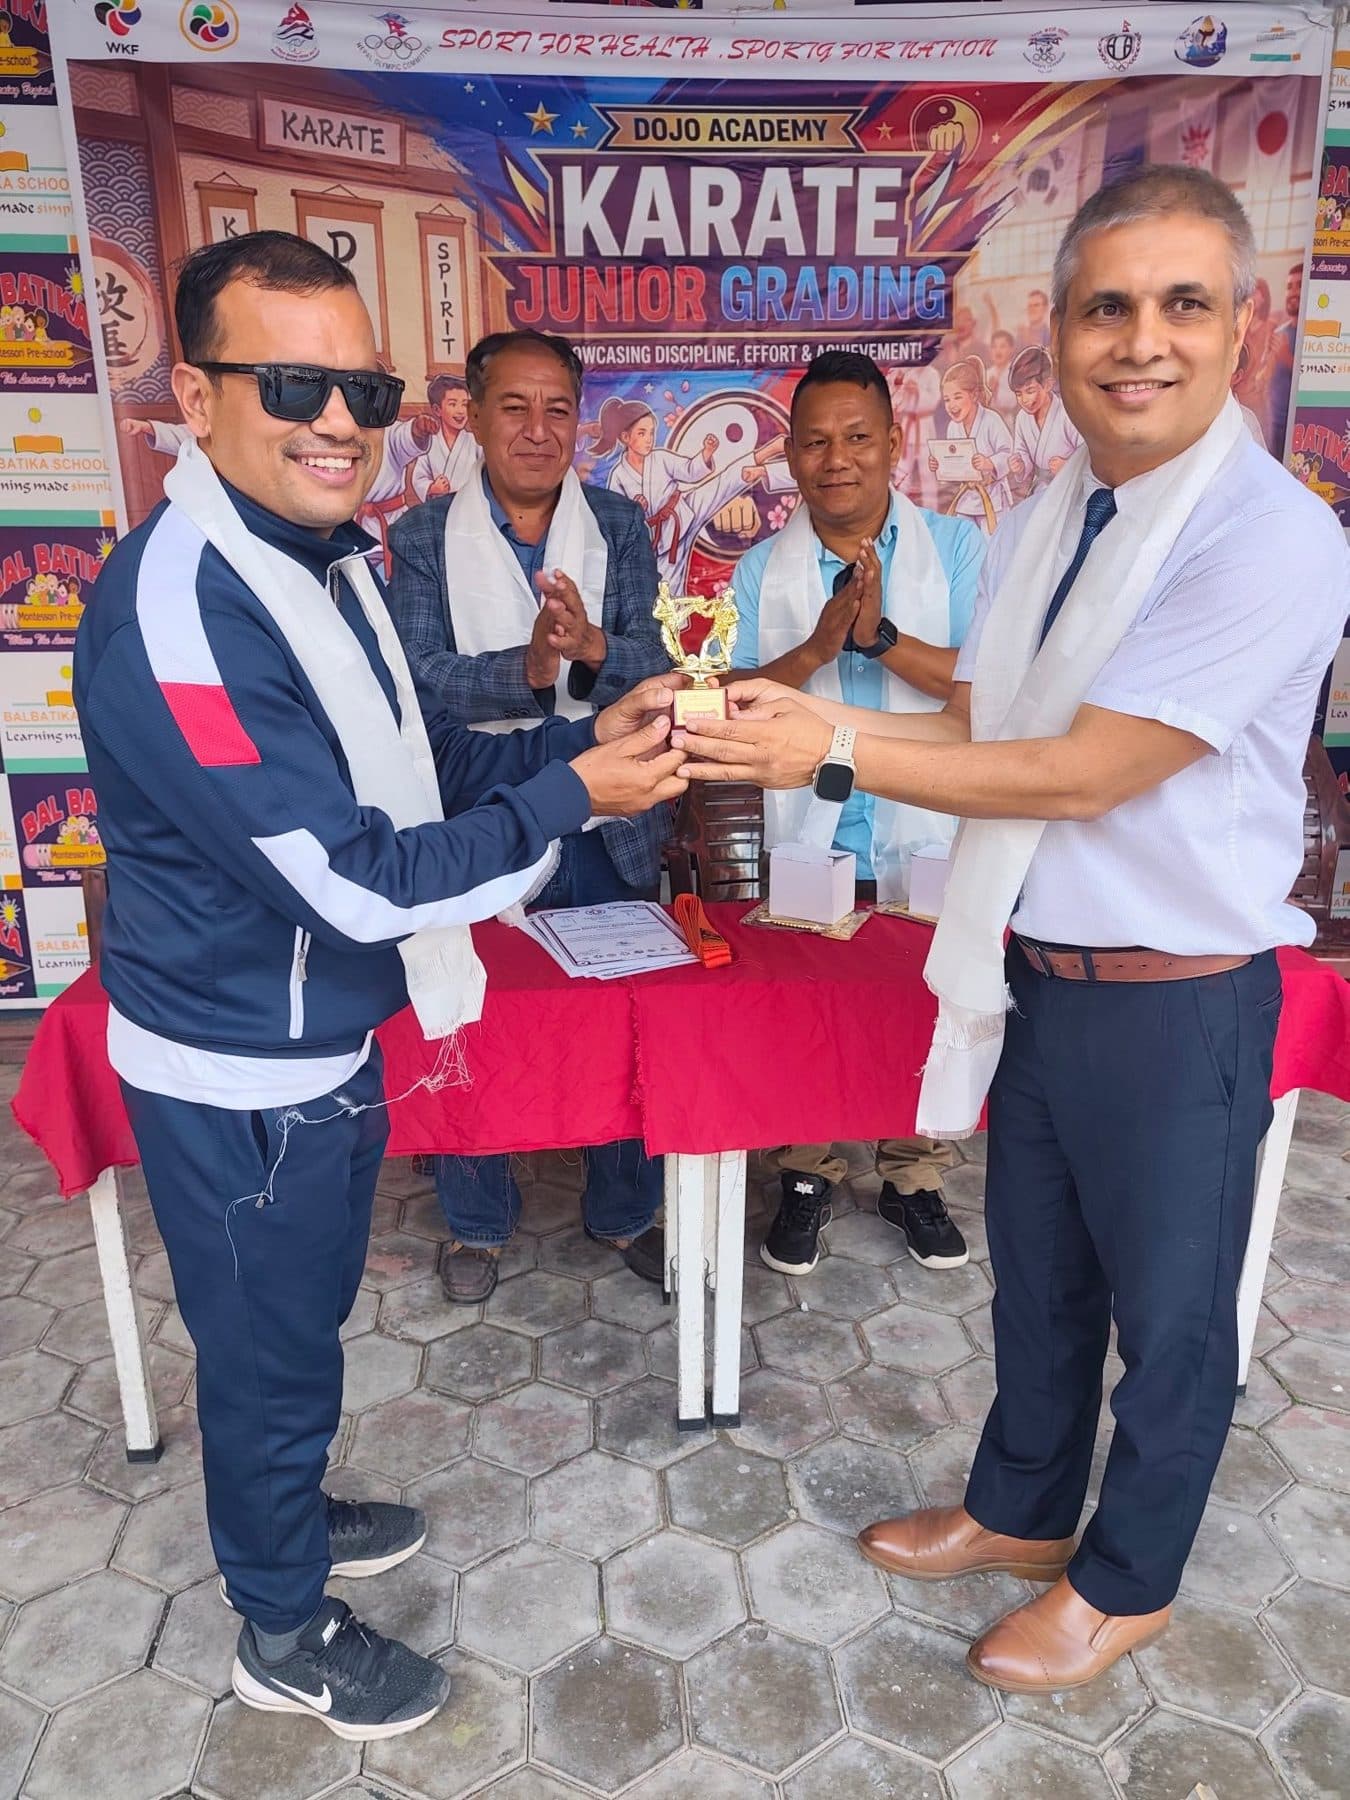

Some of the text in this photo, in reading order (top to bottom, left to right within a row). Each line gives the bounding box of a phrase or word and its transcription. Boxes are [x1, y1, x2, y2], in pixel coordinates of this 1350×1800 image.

[106, 41, 139, 55] WKF
[439, 29, 532, 52] SPORT
[539, 33, 594, 55] FOR
[599, 34, 712, 58] HEALTH
[841, 41, 895, 59] FOR
[899, 39, 1000, 59] NATION
[281, 109, 386, 155] KARATE
[634, 117, 828, 143] DOJO ACADEMY
[17, 176, 70, 191] SCHOO
[562, 165, 902, 257] KARATE
[438, 242, 456, 356] SPIRIT
[514, 265, 707, 323] JUNIOR
[720, 265, 946, 322] GRADING
[573, 345, 651, 364] OWCASING
[656, 345, 740, 366] DISCIPLINE,
[744, 344, 799, 363] EFFORT
[801, 344, 813, 362] &
[33, 543, 104, 584] BATIK
[6, 731, 63, 743] Learning
[21, 794, 65, 843] BAL
[36, 941, 86, 951] BALBAT
